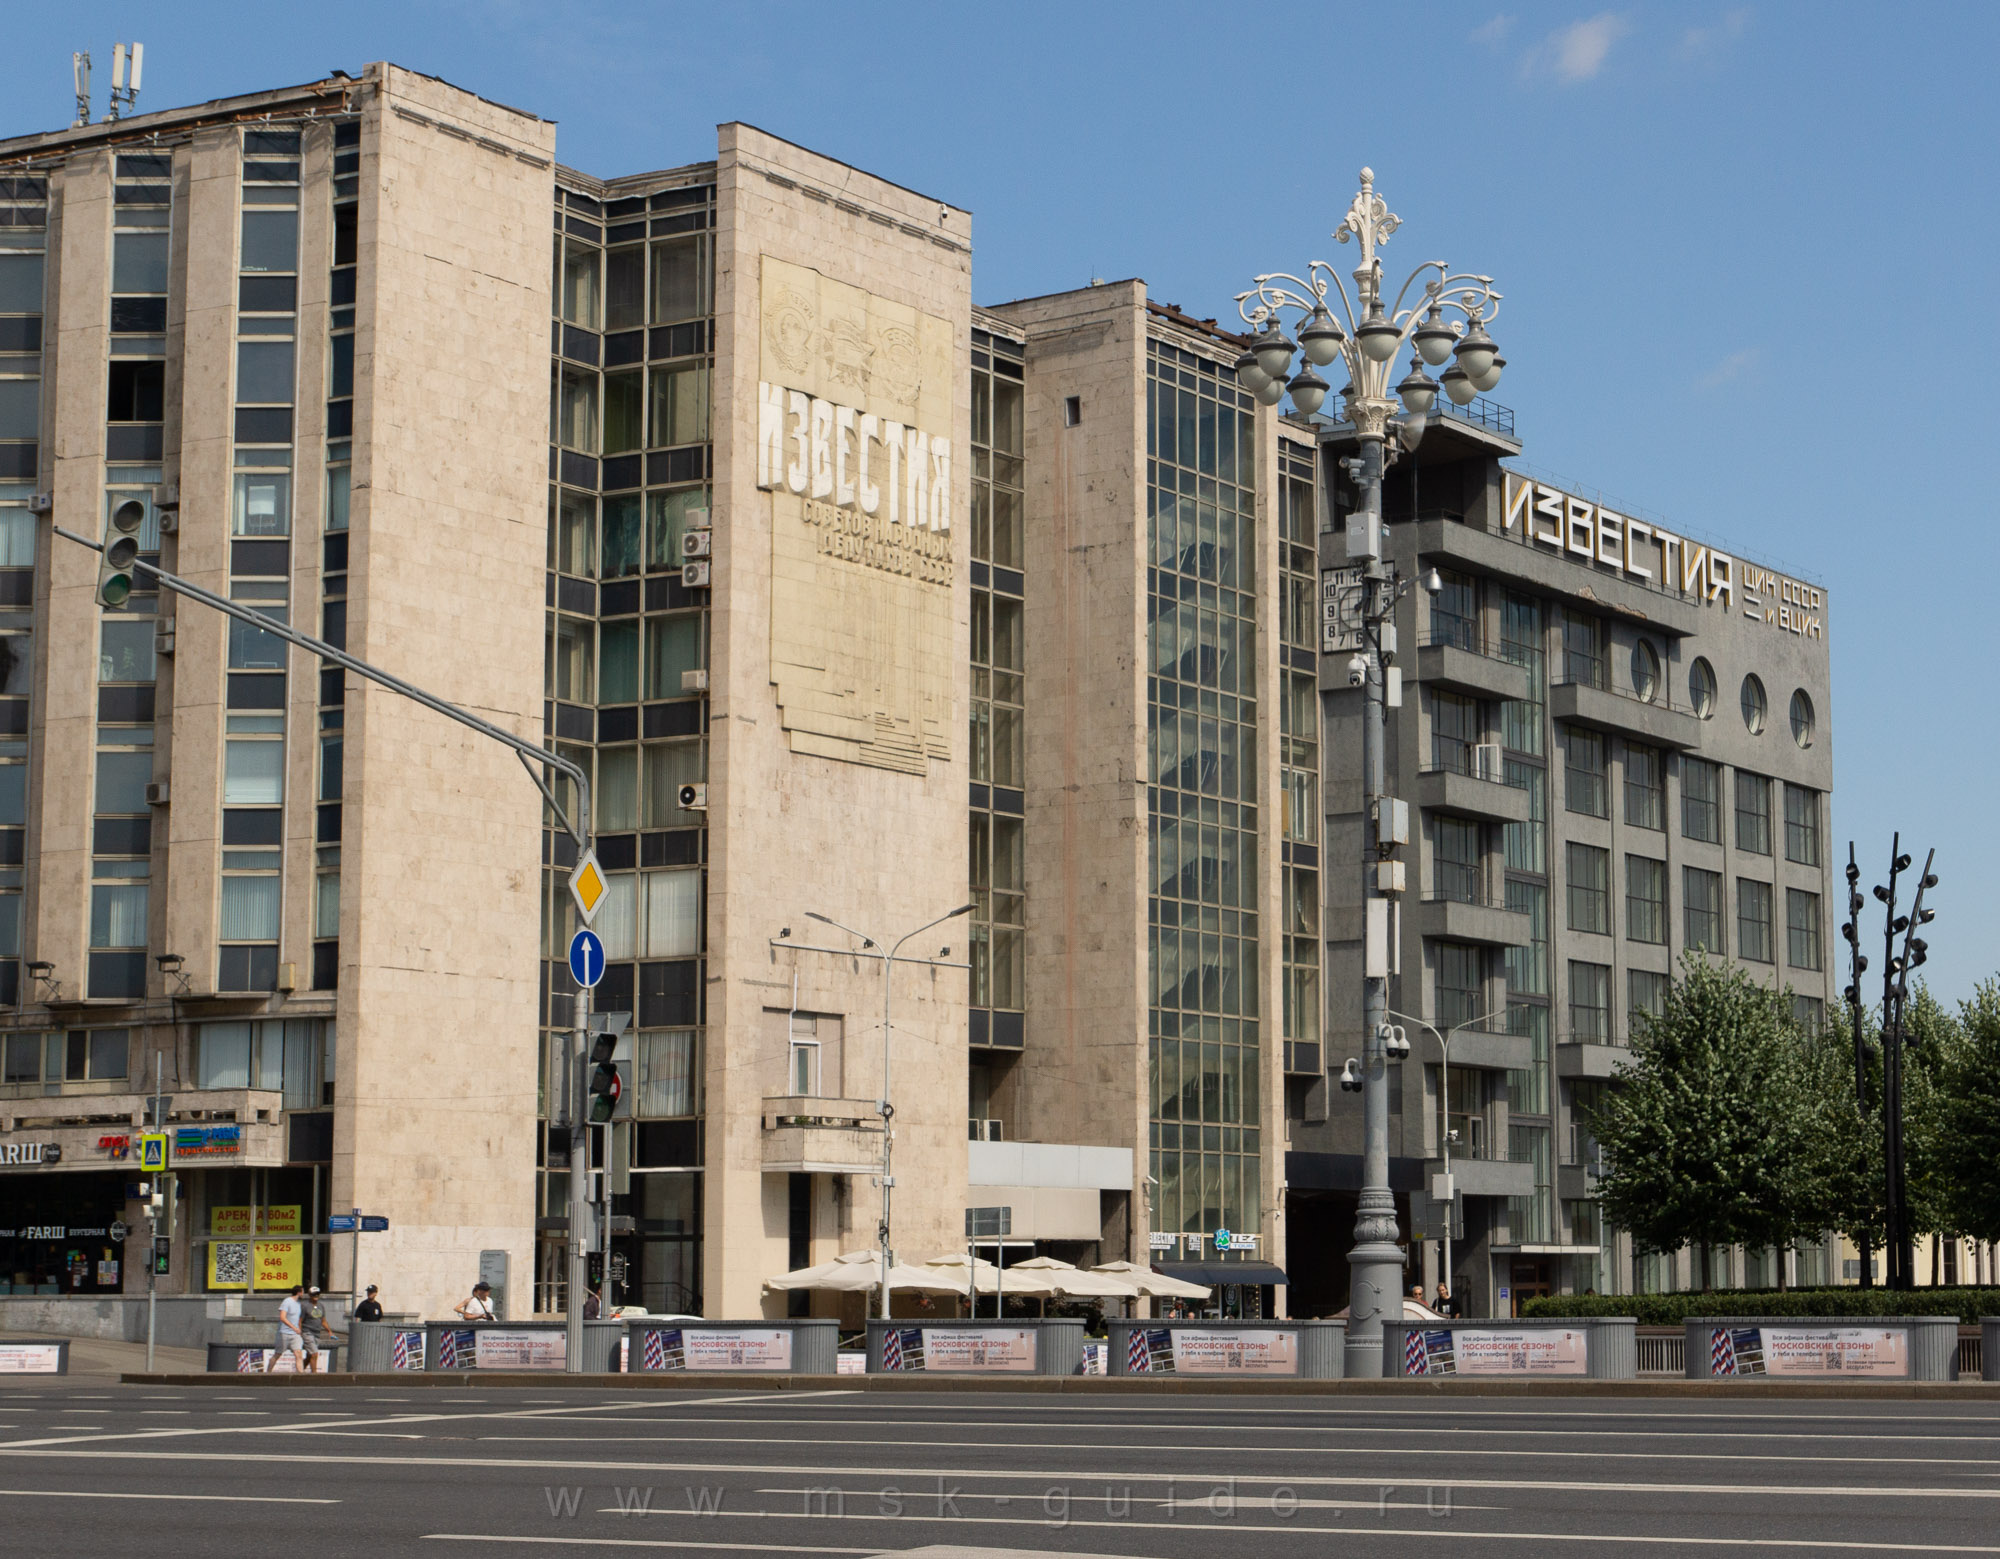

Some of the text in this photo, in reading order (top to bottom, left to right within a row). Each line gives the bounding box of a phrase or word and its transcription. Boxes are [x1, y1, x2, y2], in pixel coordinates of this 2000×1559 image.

[757, 381, 951, 532] ИЗВЕСТИЯ
[802, 498, 952, 563] СОВЕТОВ НАРОДНЫХ
[1501, 472, 1733, 606] ИЗВЕСТИЯ
[818, 529, 953, 588] ДЕПУТАТОВ СССР
[1336, 572, 1344, 585] 11
[1325, 584, 1336, 598] 10
[1742, 564, 1820, 610] ЦИК СССР
[1328, 605, 1334, 618] 9
[1766, 605, 1822, 640] и ВЦИК
[1328, 626, 1336, 638] 8
[1339, 634, 1345, 646] 7
[217, 1209, 296, 1221] АРЕНА 60м2
[1230, 1233, 1256, 1243] TEZ
[264, 1244, 292, 1252] 7-925
[264, 1258, 282, 1266] 646
[260, 1272, 288, 1280] 26-88
[1772, 1342, 1873, 1350] МОСКОВСКИЕ СЕЗОНЫ
